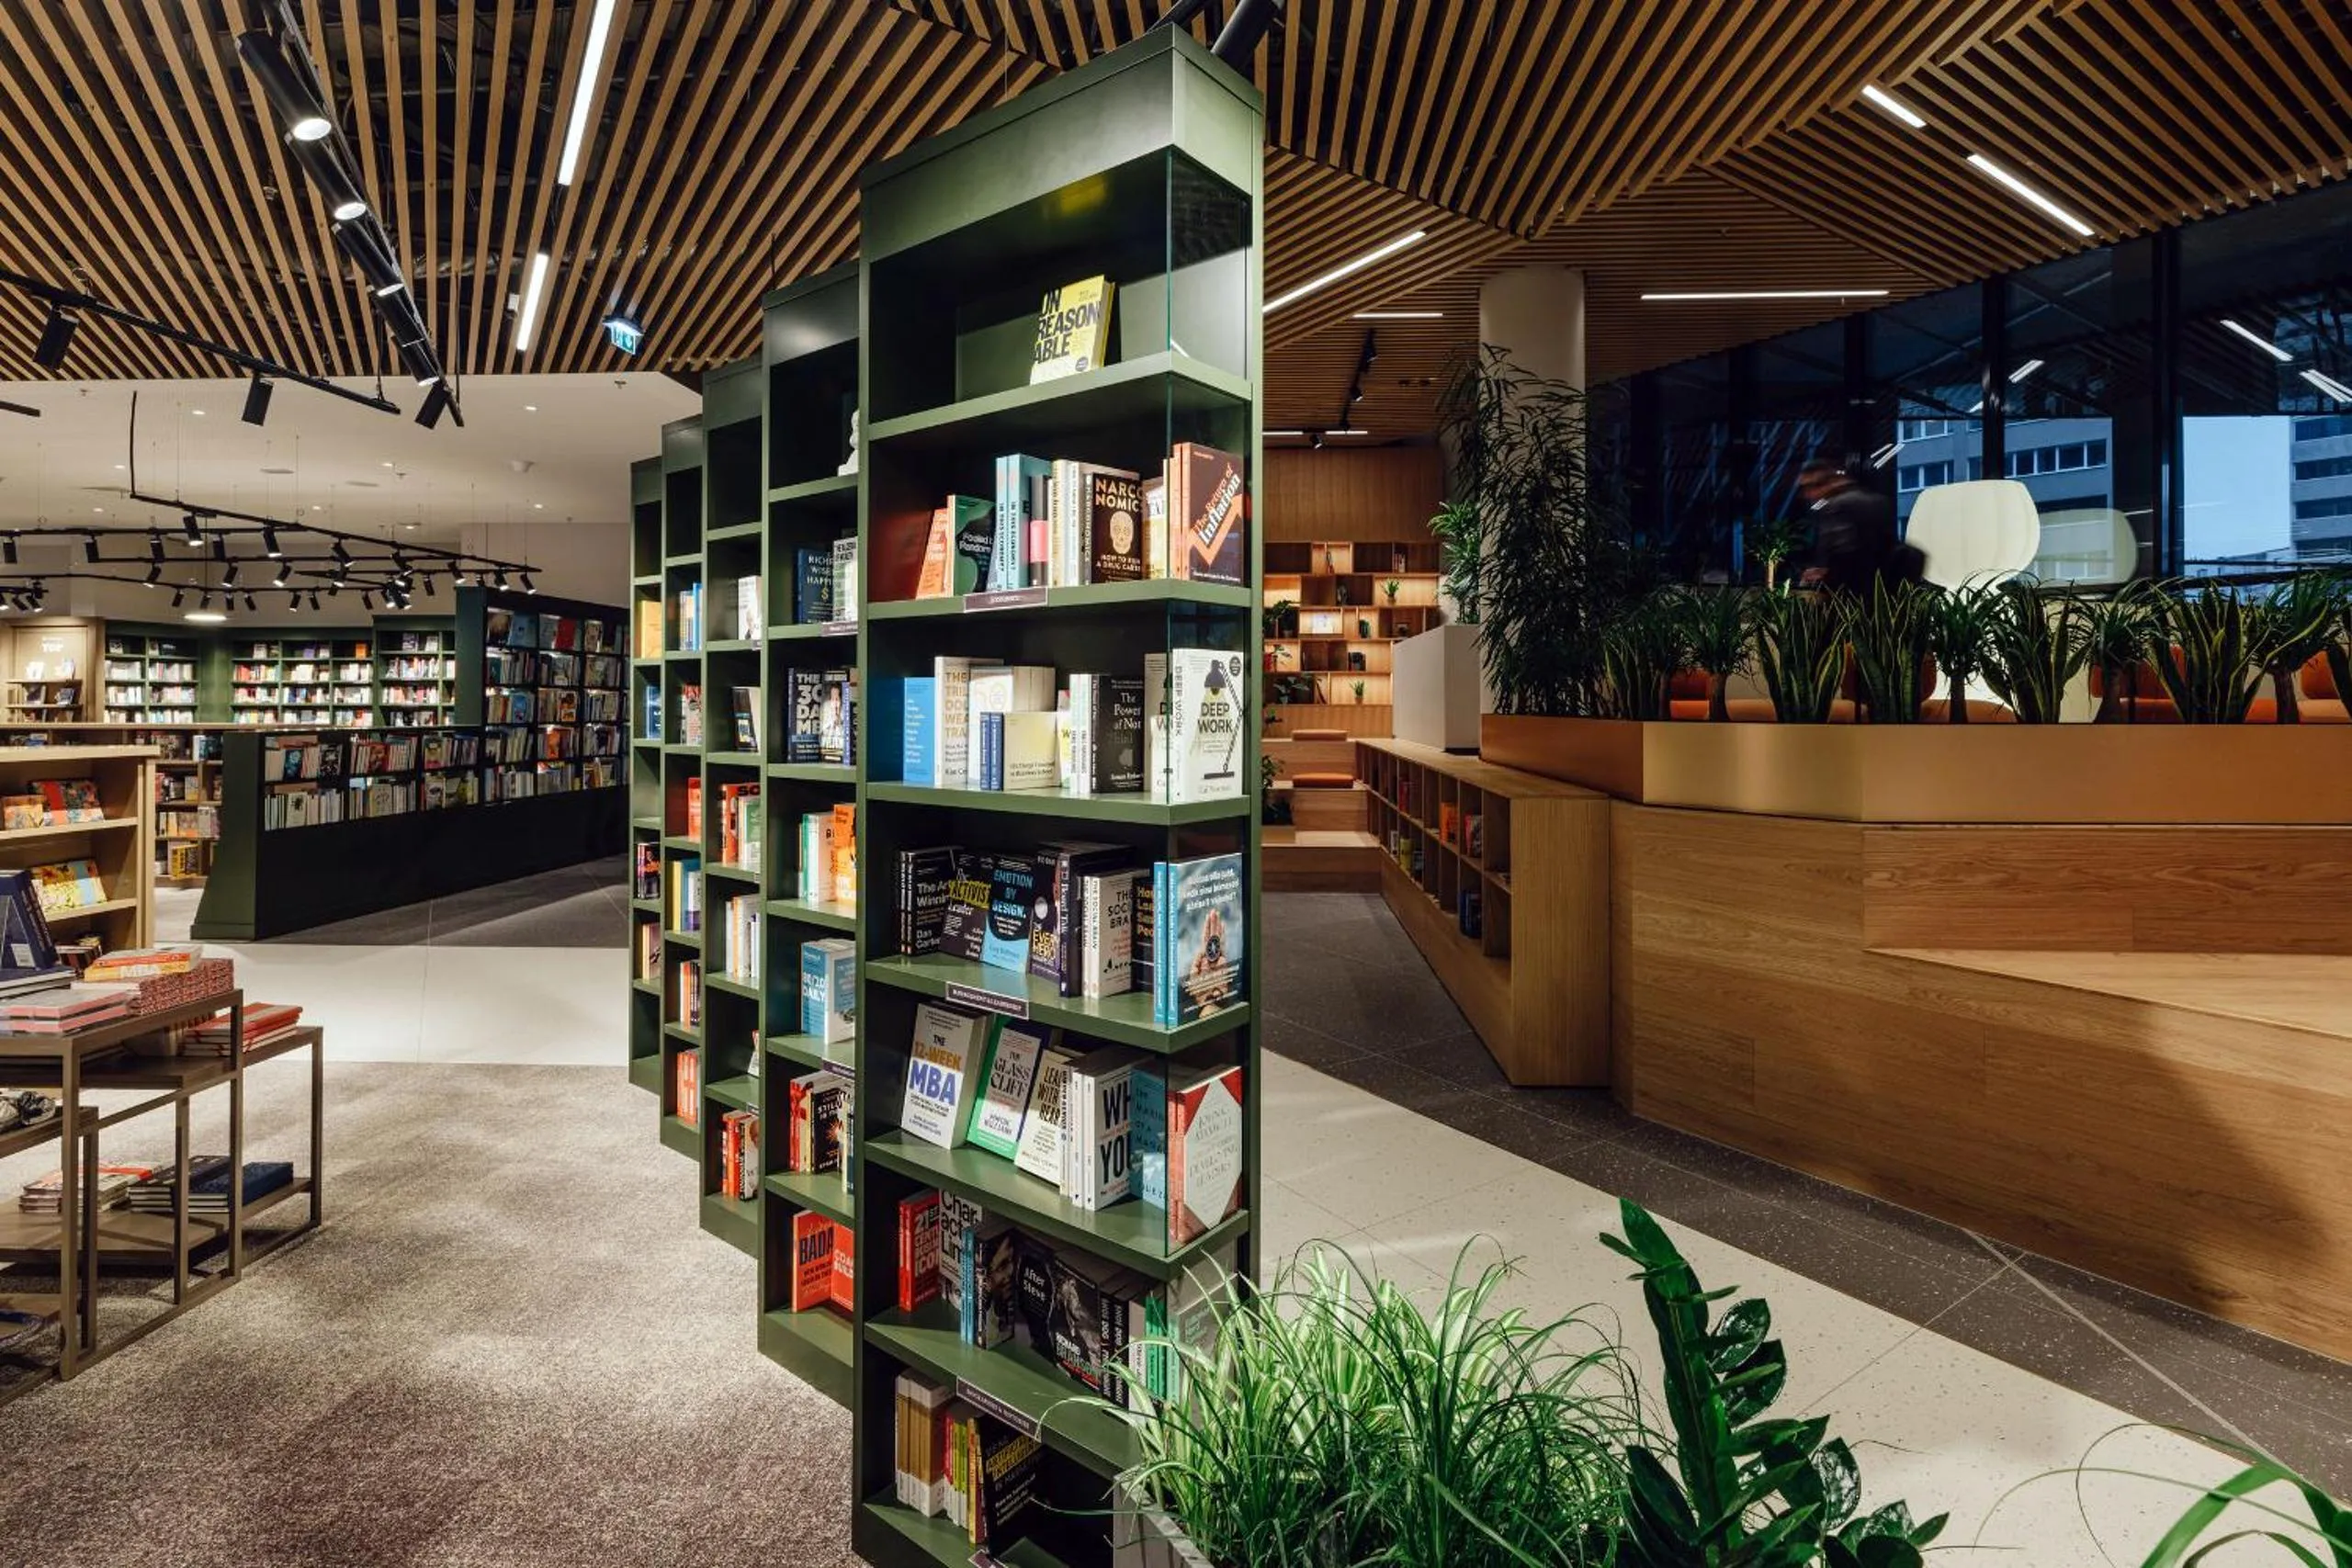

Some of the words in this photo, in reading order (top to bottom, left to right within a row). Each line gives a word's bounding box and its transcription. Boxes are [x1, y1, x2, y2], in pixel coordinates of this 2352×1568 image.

[1037, 301, 1101, 341] REASON
[1034, 333, 1072, 364] ABLE
[1095, 492, 1141, 513] NOMIC
[1199, 472, 1241, 547] Inflation
[797, 673, 820, 684] THE
[945, 671, 967, 683] THE
[1121, 692, 1136, 703] The
[797, 704, 820, 719] DA
[1114, 704, 1141, 716] Power
[1200, 702, 1229, 716] DEEP
[797, 718, 823, 736] MB
[1114, 718, 1123, 729] of
[1124, 717, 1141, 729] Not
[1197, 719, 1233, 734] WORK
[992, 869, 1035, 888] EMOTION
[917, 882, 936, 894] The
[1005, 887, 1017, 899] BY
[1116, 890, 1129, 902] TH
[1108, 903, 1129, 917] SOC
[1110, 917, 1130, 929] BRA
[914, 1041, 962, 1072] 12-WEEK
[994, 1057, 1032, 1082] GLASS
[909, 1059, 956, 1107] MBA
[990, 1072, 1029, 1099] CLIFF
[800, 1226, 834, 1267] BADA
[1023, 1267, 1046, 1288] After
[1023, 1280, 1046, 1303] Steve
